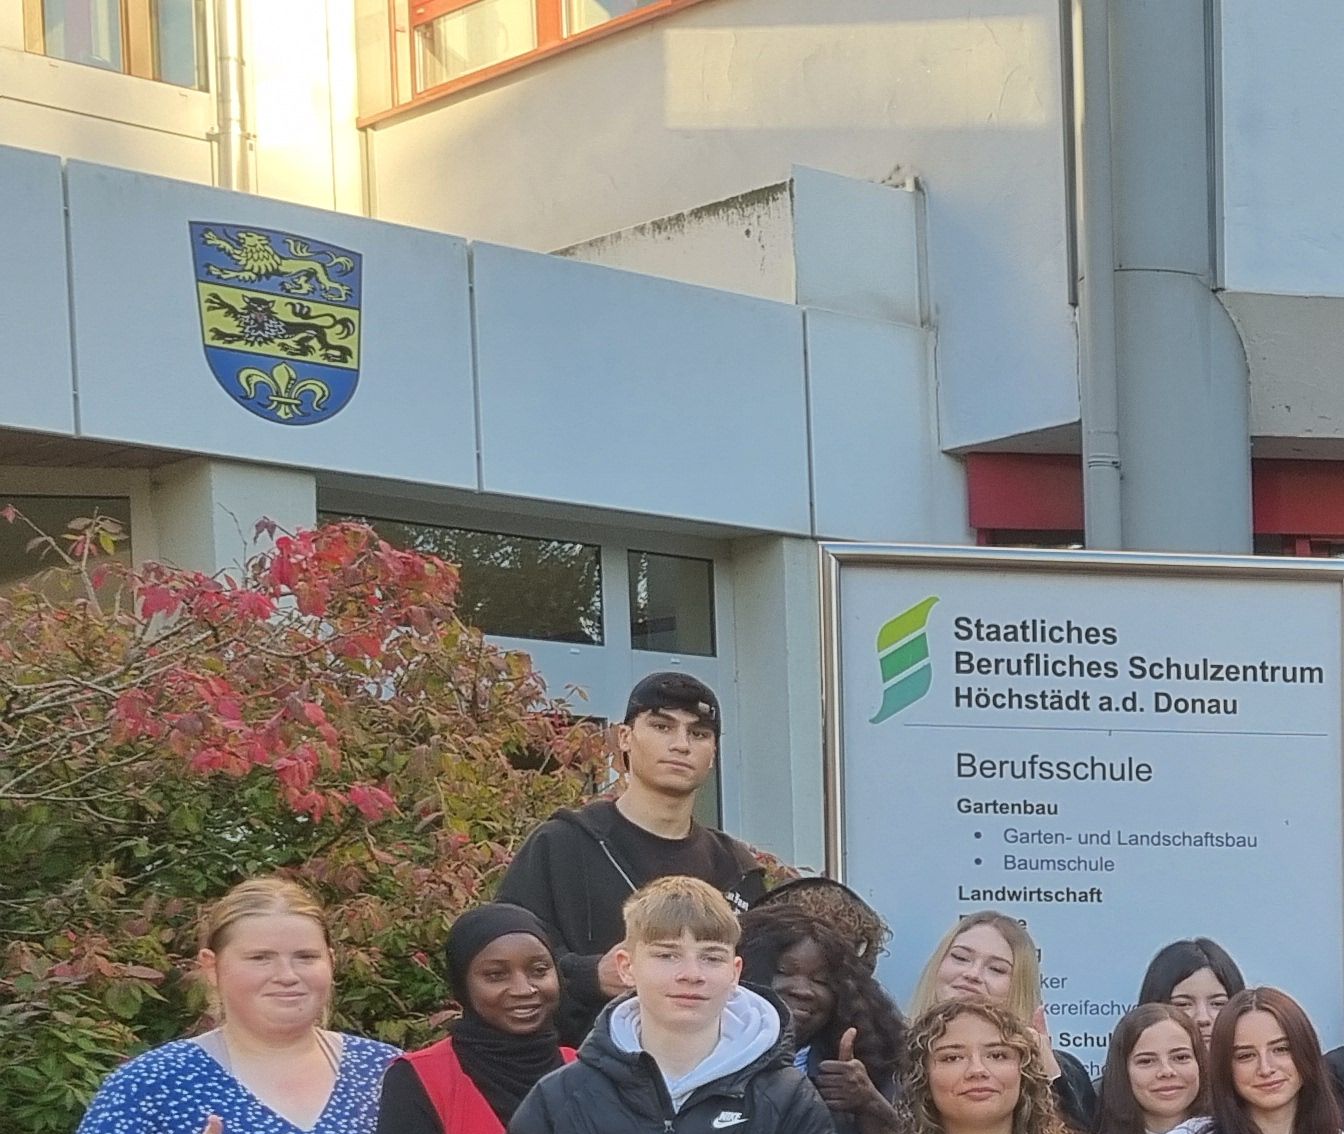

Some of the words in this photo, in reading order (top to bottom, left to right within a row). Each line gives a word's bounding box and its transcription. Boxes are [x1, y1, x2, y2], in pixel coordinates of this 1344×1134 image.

[953, 616, 1118, 646] Staatliches
[954, 650, 1119, 680] Berufliches
[1128, 656, 1325, 684] Schulzentrum
[954, 686, 1091, 713] Höchstädt
[1098, 690, 1145, 714] a.d.
[1153, 693, 1239, 716] Donau
[956, 752, 1154, 783] Berufsschule
[956, 797, 1059, 816] Gartenbau
[1003, 828, 1073, 845] Garten-
[1077, 829, 1111, 846] und
[1117, 829, 1258, 849] Landschaftsbau
[1003, 854, 1115, 872] Baumschule
[957, 884, 1103, 904] Landwirtschaft
[1040, 974, 1067, 990] ker
[1059, 1032, 1112, 1048] Schul
